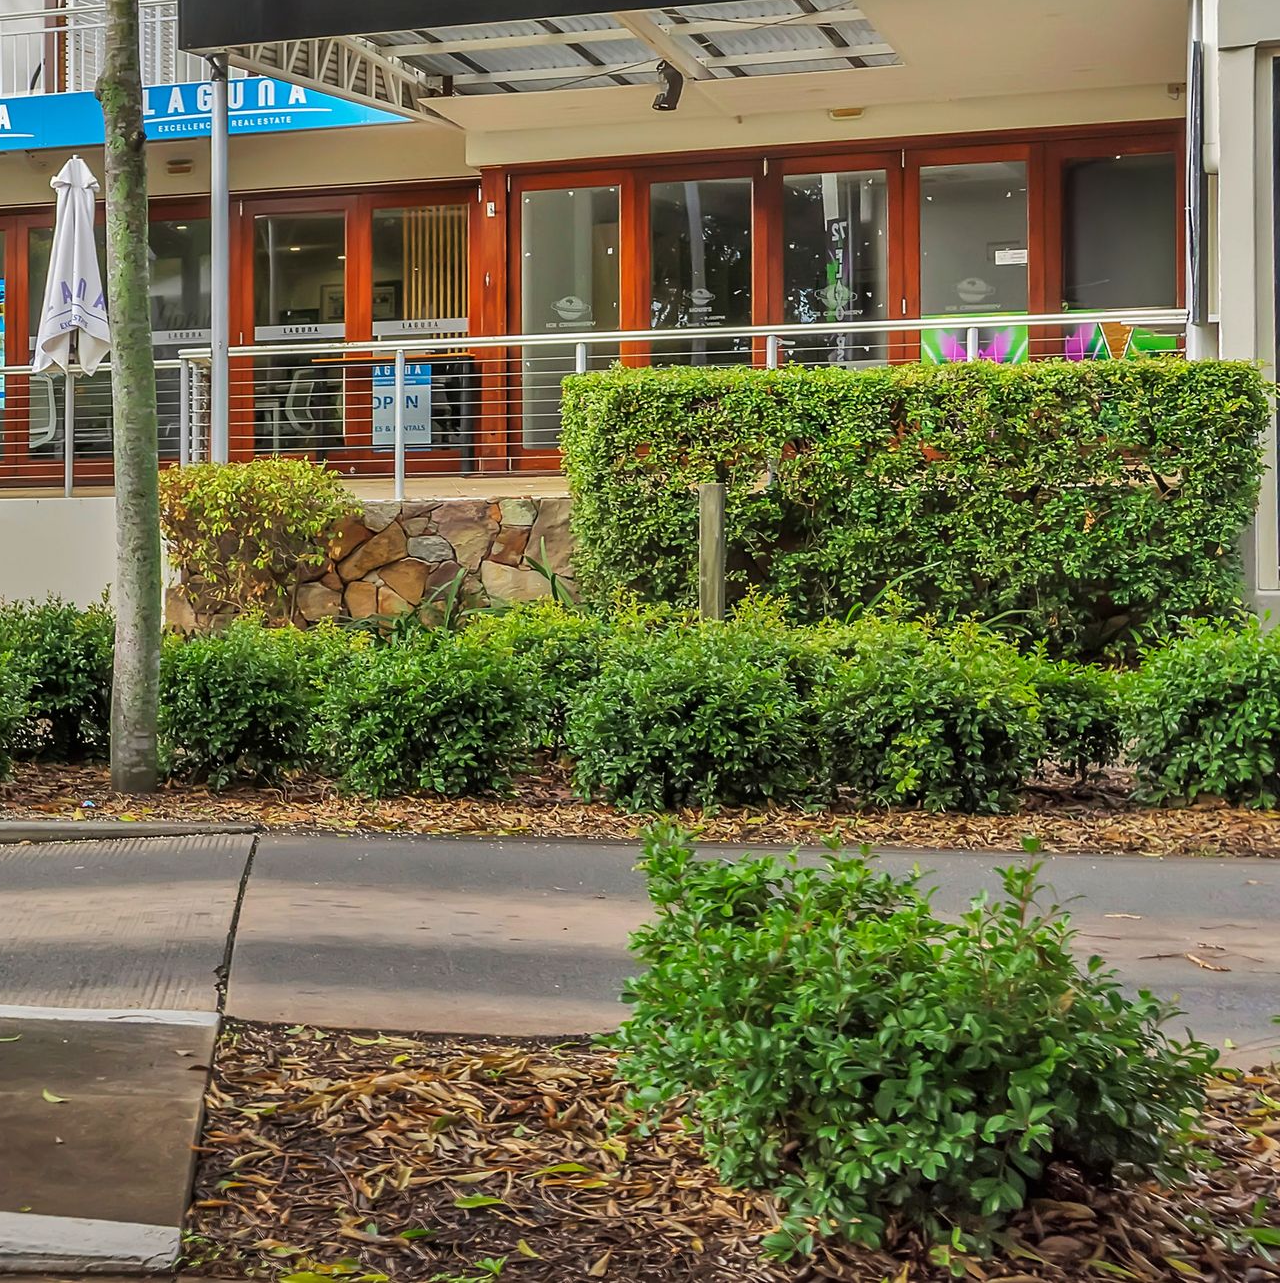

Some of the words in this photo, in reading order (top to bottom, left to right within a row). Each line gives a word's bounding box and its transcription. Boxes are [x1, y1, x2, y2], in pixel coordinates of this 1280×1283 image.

[143, 80, 307, 115] LAGUNA
[158, 122, 211, 133] EXCELLENC
[231, 118, 255, 127] REAL
[257, 116, 292, 126] ESTATE
[283, 326, 319, 334] LAGUNA
[402, 321, 439, 329] LAGUNA
[168, 331, 203, 339] LAGUNA
[374, 365, 422, 376] AGNA
[373, 395, 418, 410] OPN
